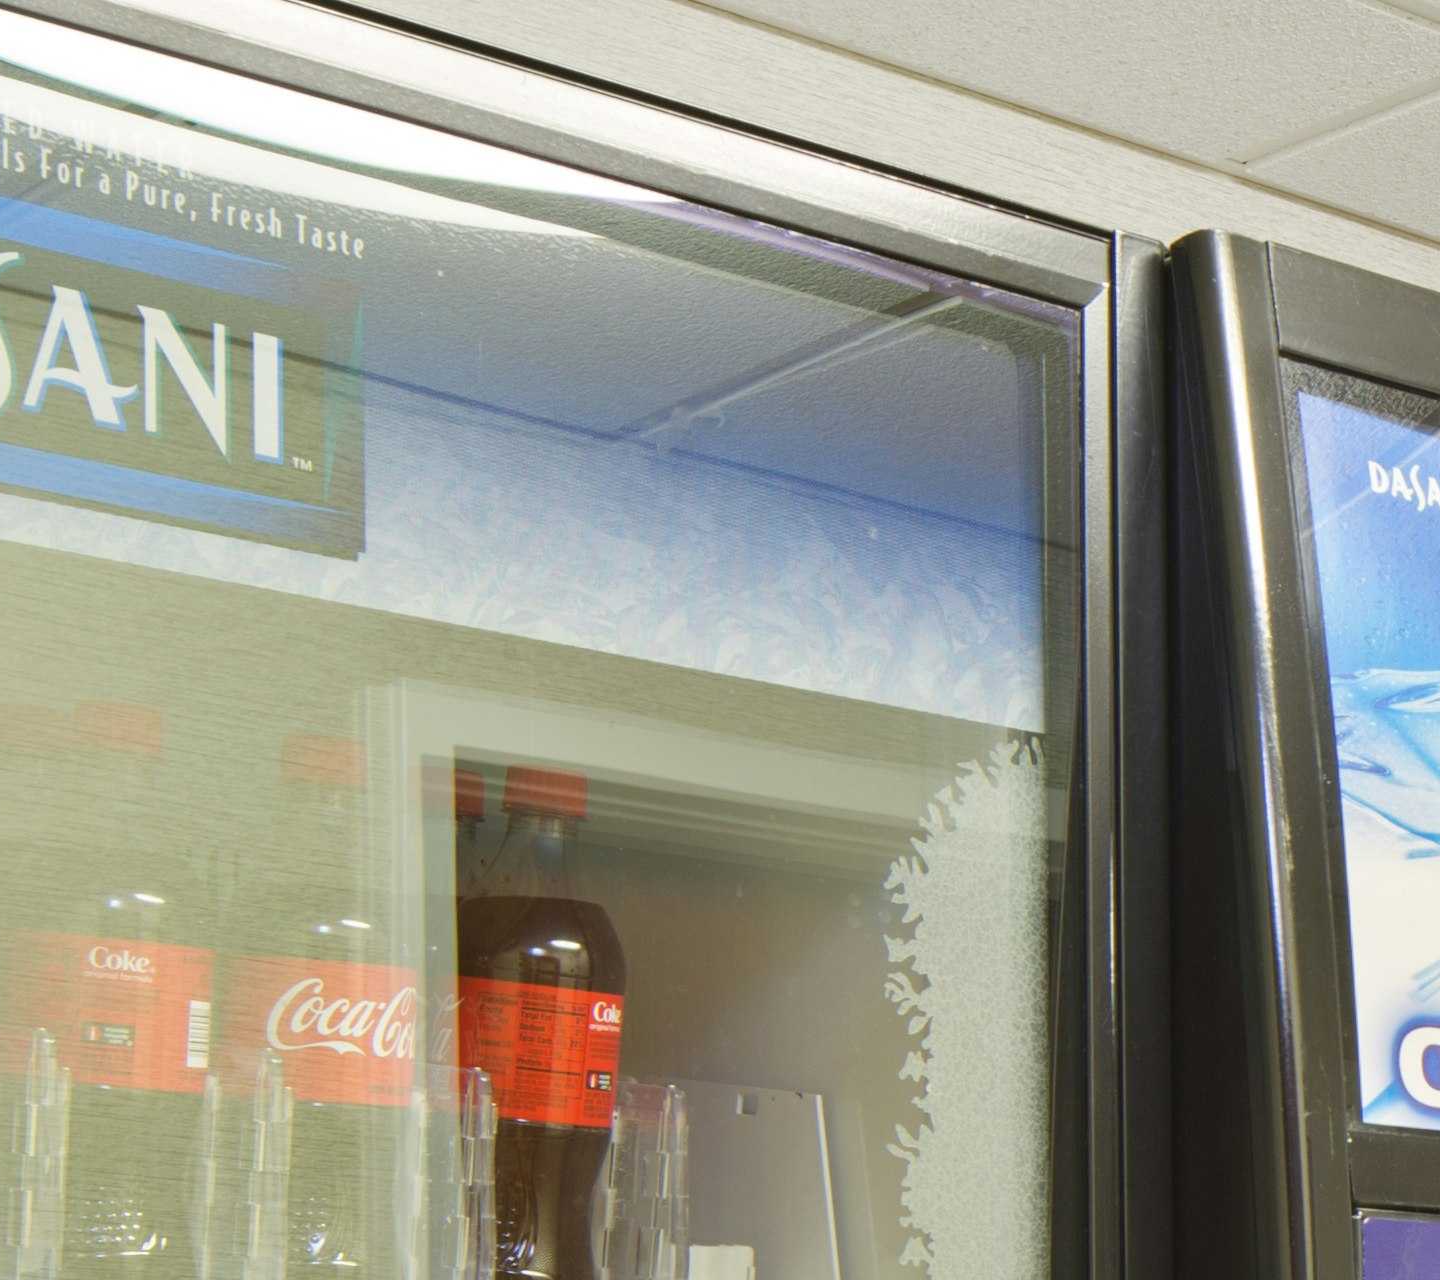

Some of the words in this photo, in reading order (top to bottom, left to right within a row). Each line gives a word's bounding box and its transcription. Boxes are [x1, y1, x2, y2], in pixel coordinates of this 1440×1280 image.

[74, 118, 197, 180] WATER
[40, 148, 84, 188] For
[99, 169, 111, 196] a
[126, 172, 198, 224] Pure,
[211, 193, 283, 240] Fresh
[295, 214, 366, 259] Taste
[84, 970, 118, 980] original
[120, 973, 153, 983] formula
[89, 946, 150, 973] Coke
